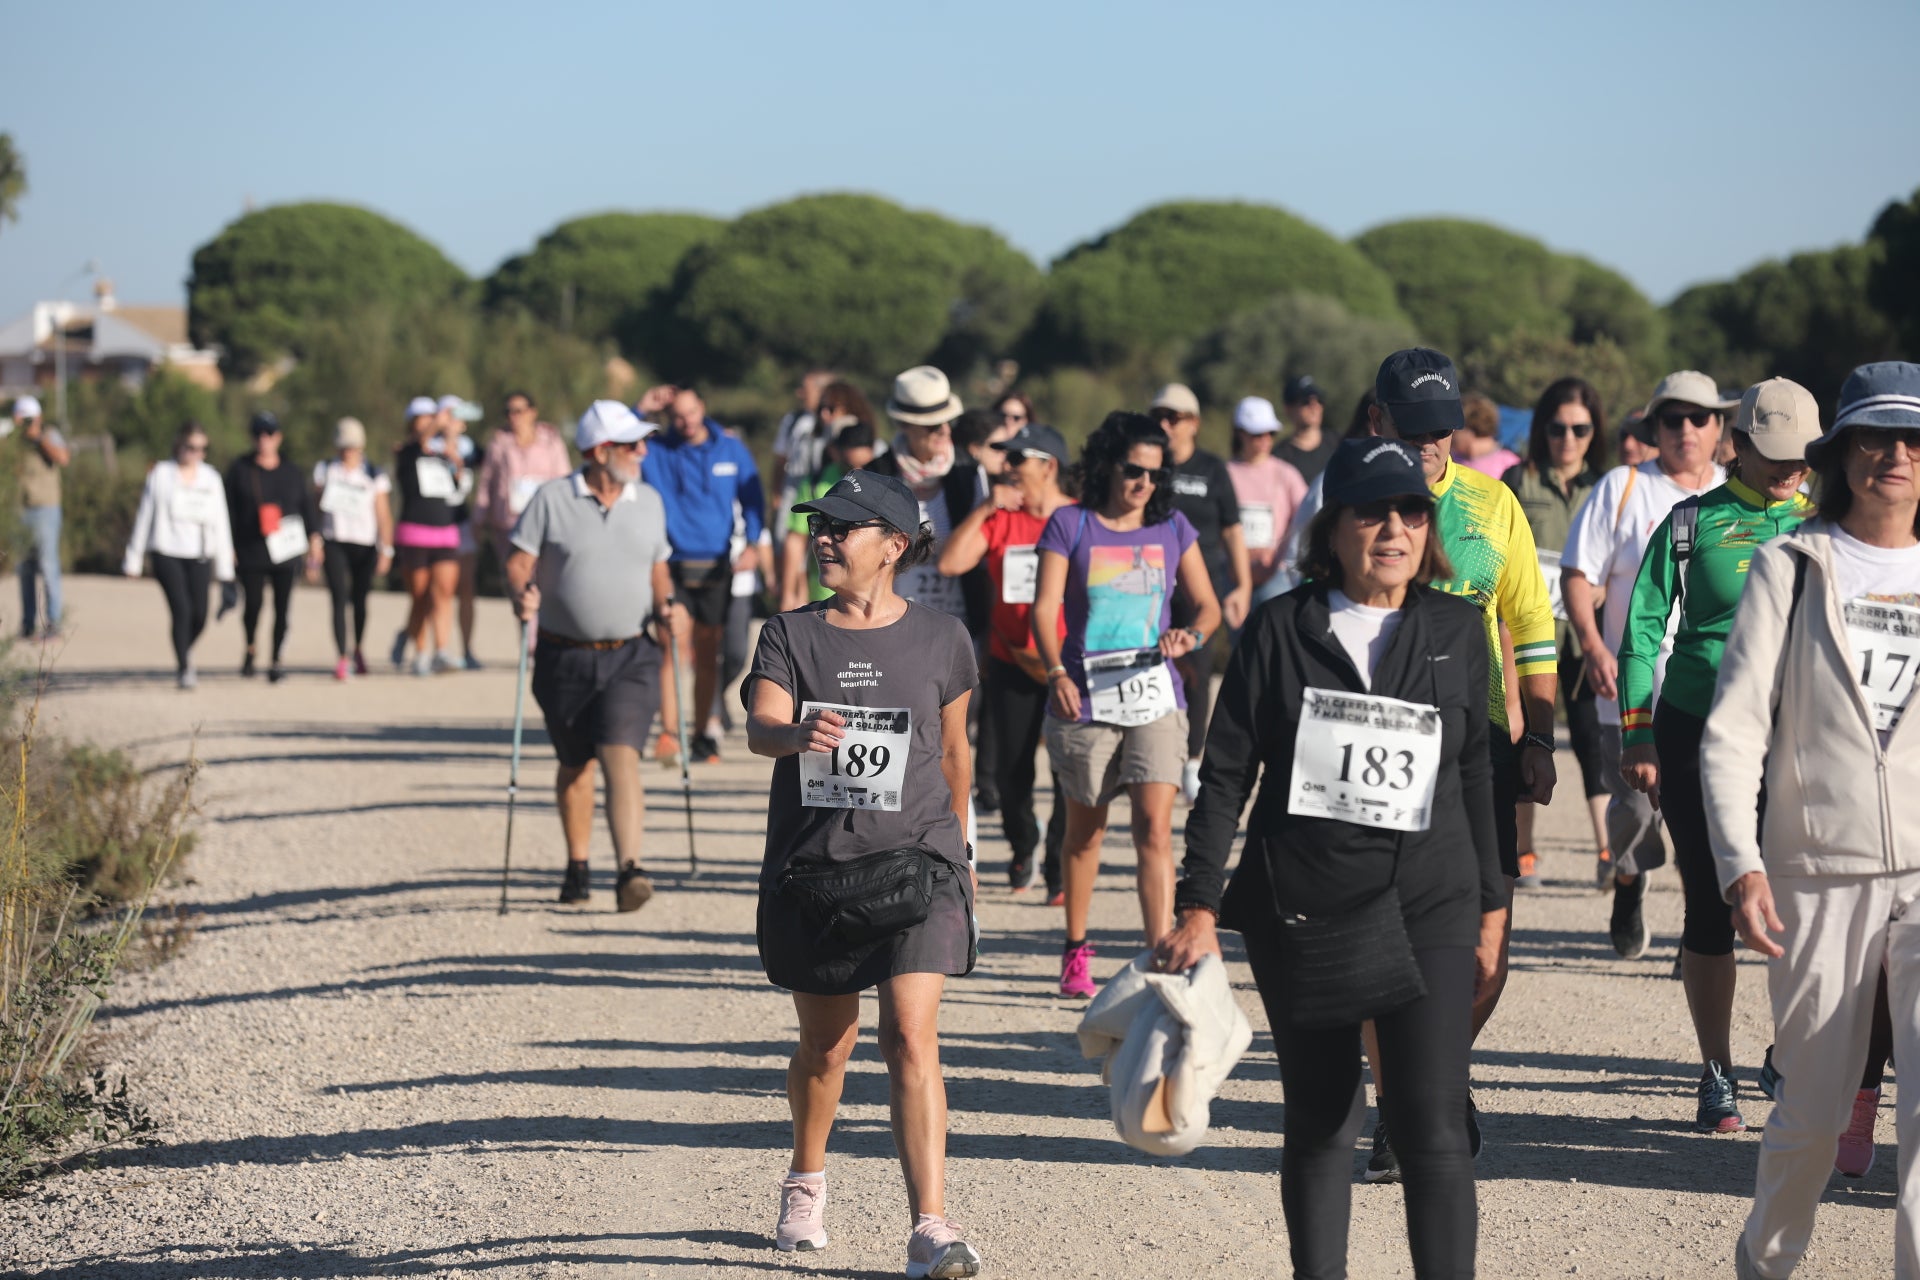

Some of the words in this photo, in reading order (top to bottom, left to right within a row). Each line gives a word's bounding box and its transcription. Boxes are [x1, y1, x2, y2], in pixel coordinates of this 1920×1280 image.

[848, 661, 872, 669] Being
[837, 671, 873, 679] different
[840, 680, 879, 688] beautiful.
[1117, 676, 1160, 704] 195
[827, 743, 890, 778] 189
[1335, 743, 1414, 790] 183
